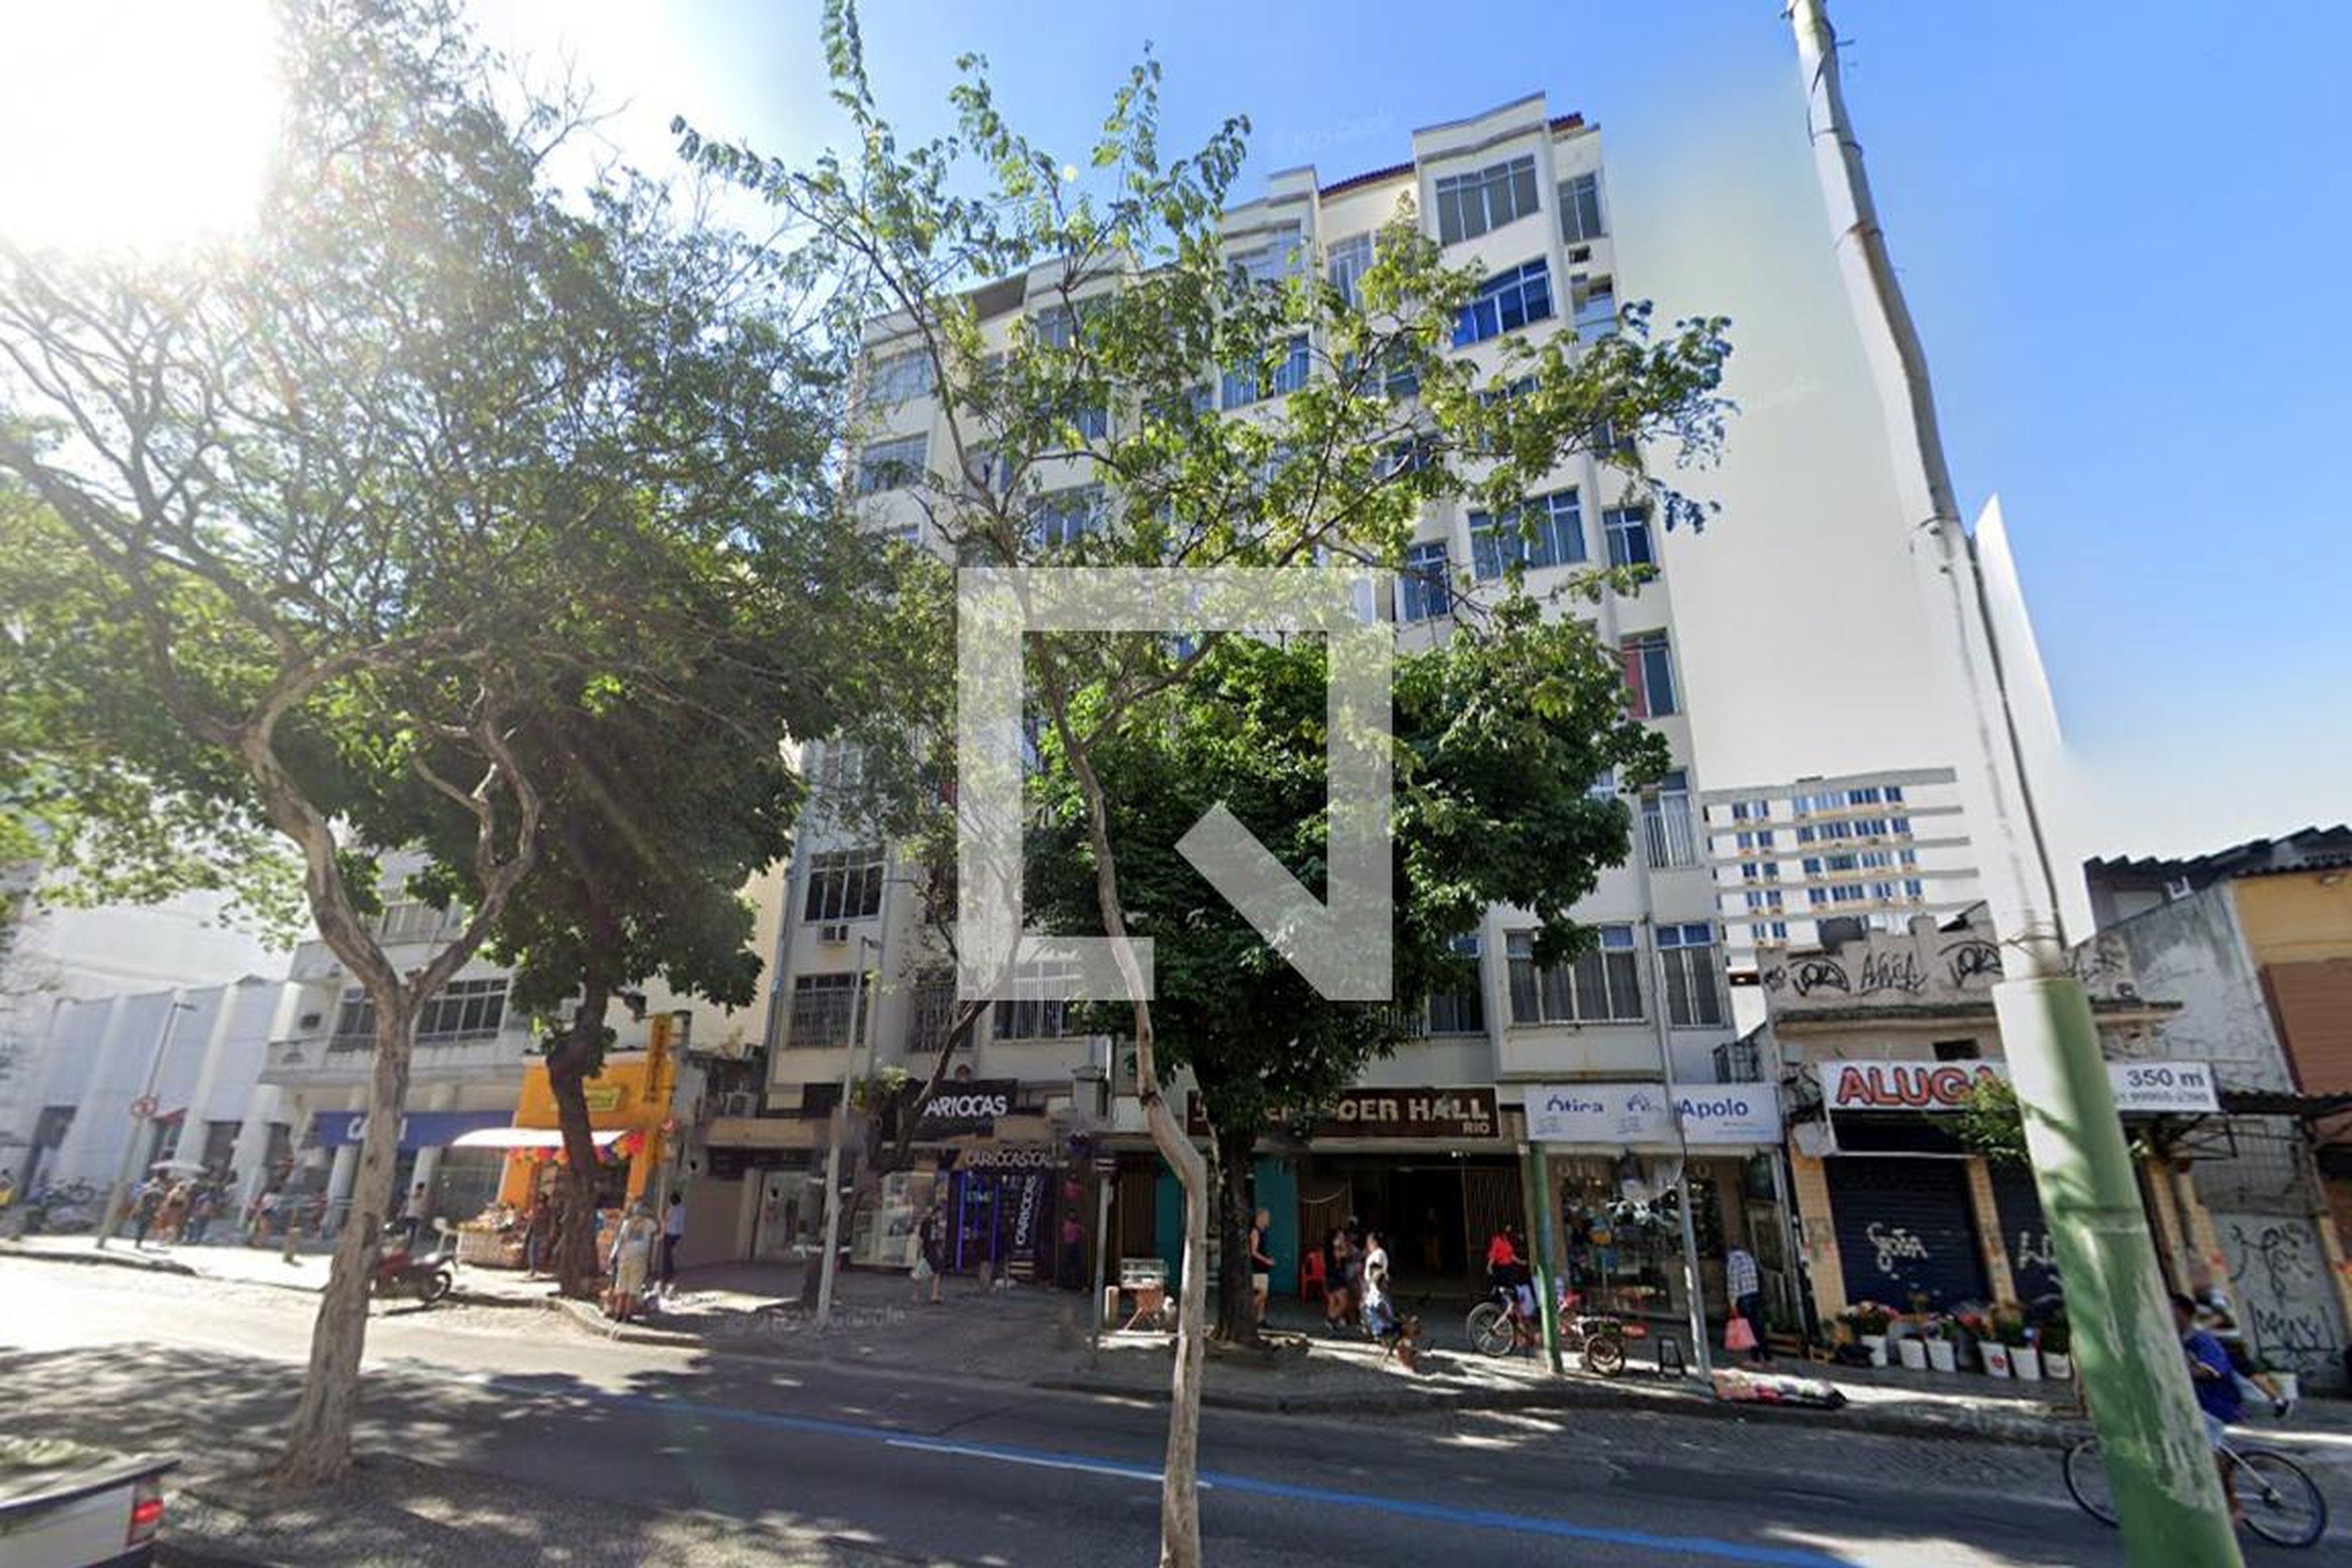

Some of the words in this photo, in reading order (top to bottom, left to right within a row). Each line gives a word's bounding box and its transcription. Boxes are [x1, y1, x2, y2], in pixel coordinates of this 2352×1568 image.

[2127, 1068, 2174, 1087] 350
[2179, 1073, 2204, 1088] m
[923, 1095, 1007, 1117] ARIOCAS
[1408, 1098, 1490, 1121] HALL
[1676, 1098, 1749, 1120] Apolo
[1462, 1121, 1490, 1134] RIO
